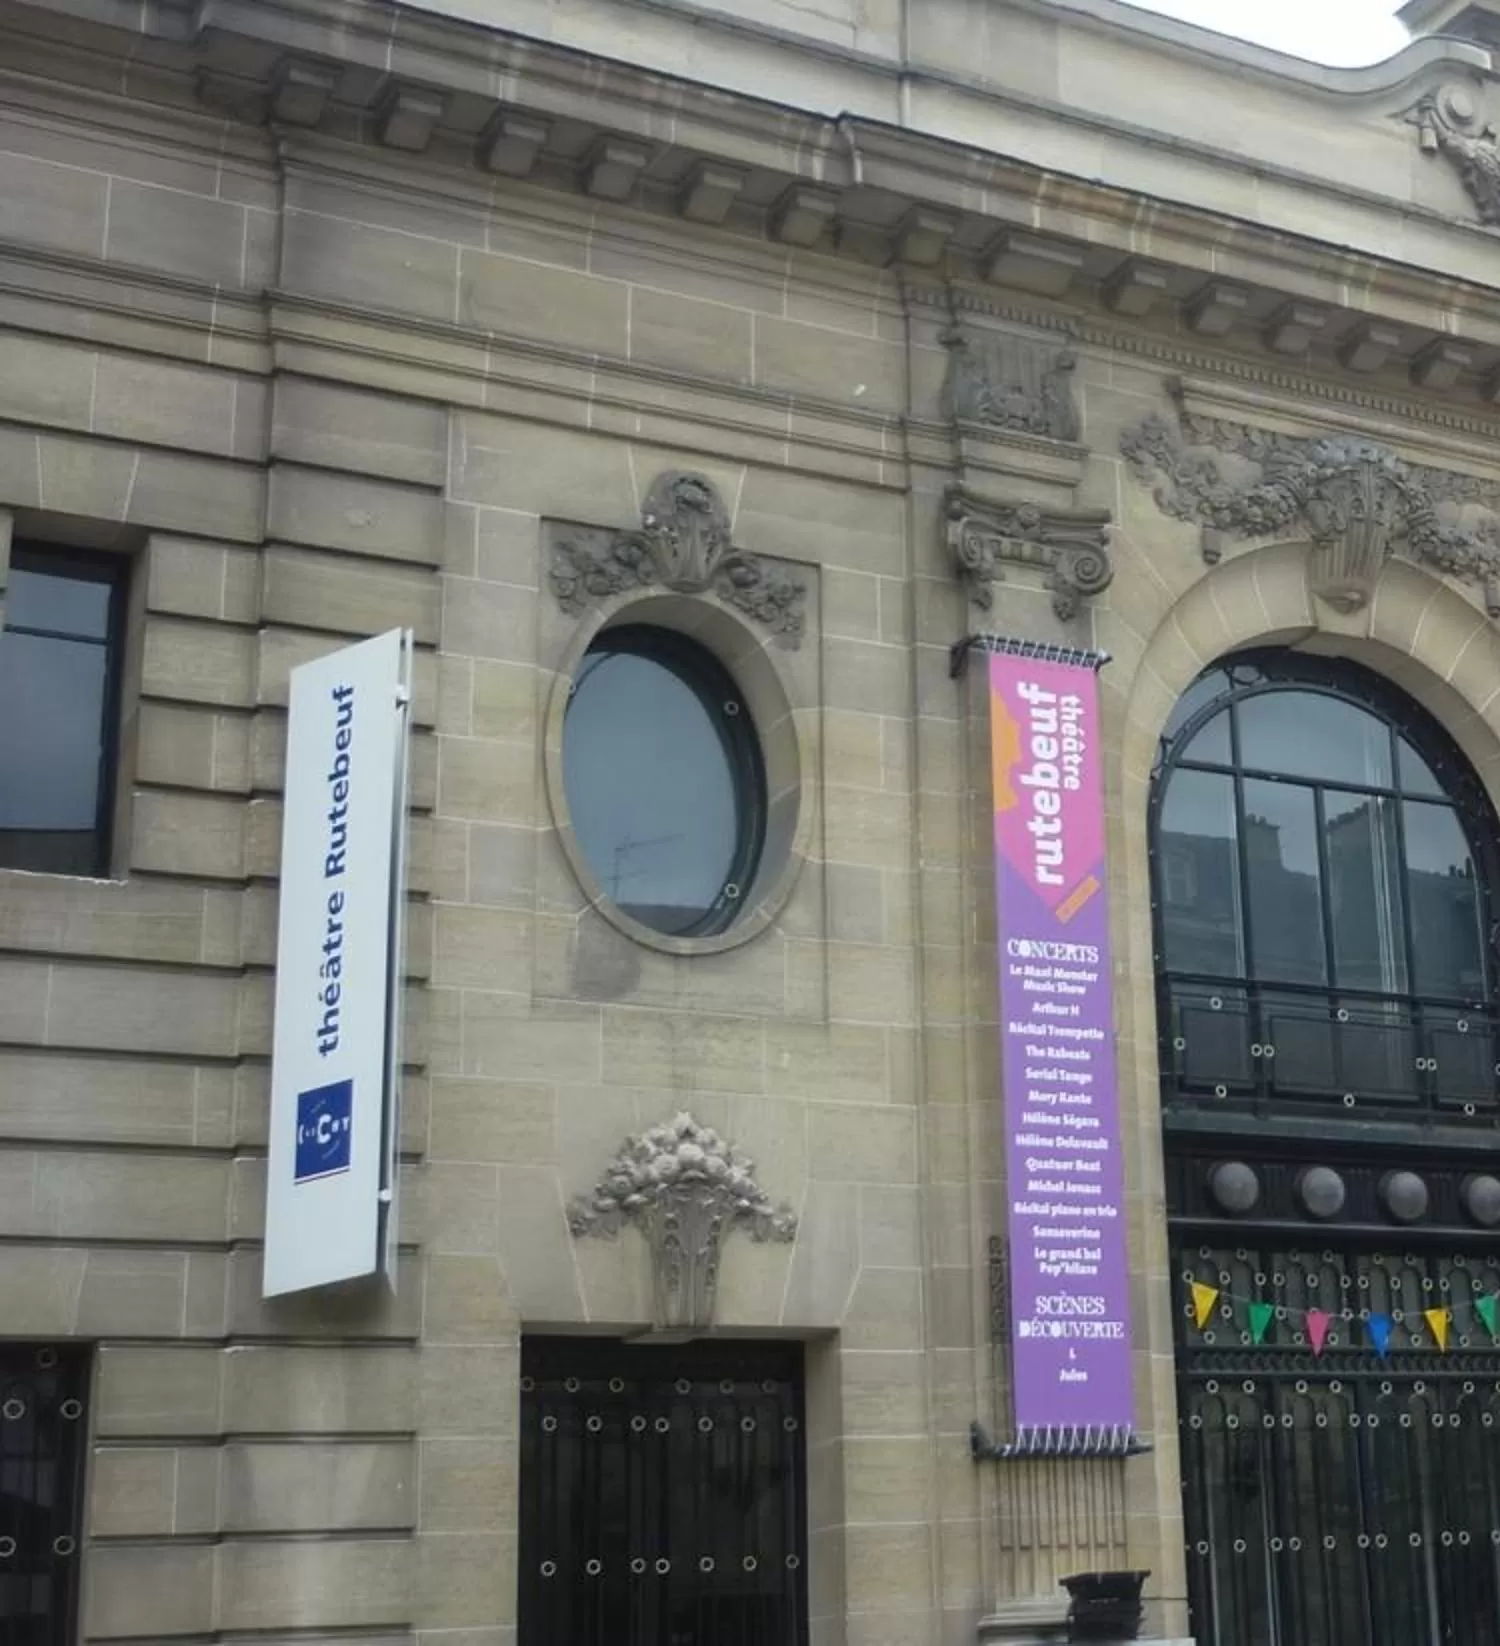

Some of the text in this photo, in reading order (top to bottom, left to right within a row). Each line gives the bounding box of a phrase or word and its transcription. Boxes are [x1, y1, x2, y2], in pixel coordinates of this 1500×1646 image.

[1060, 695, 1086, 790] théâtre
[1017, 681, 1064, 885] rutebeuf
[317, 684, 355, 1058] théâtre Rutebeuf
[1007, 938, 1099, 964] CONCERTS
[1009, 964, 1022, 975] Le
[1032, 1002, 1069, 1015] Arthur
[1025, 1044, 1045, 1057] The
[1035, 1291, 1105, 1316] SCÈNES
[1019, 1316, 1124, 1338] DÉCOUVERTE
